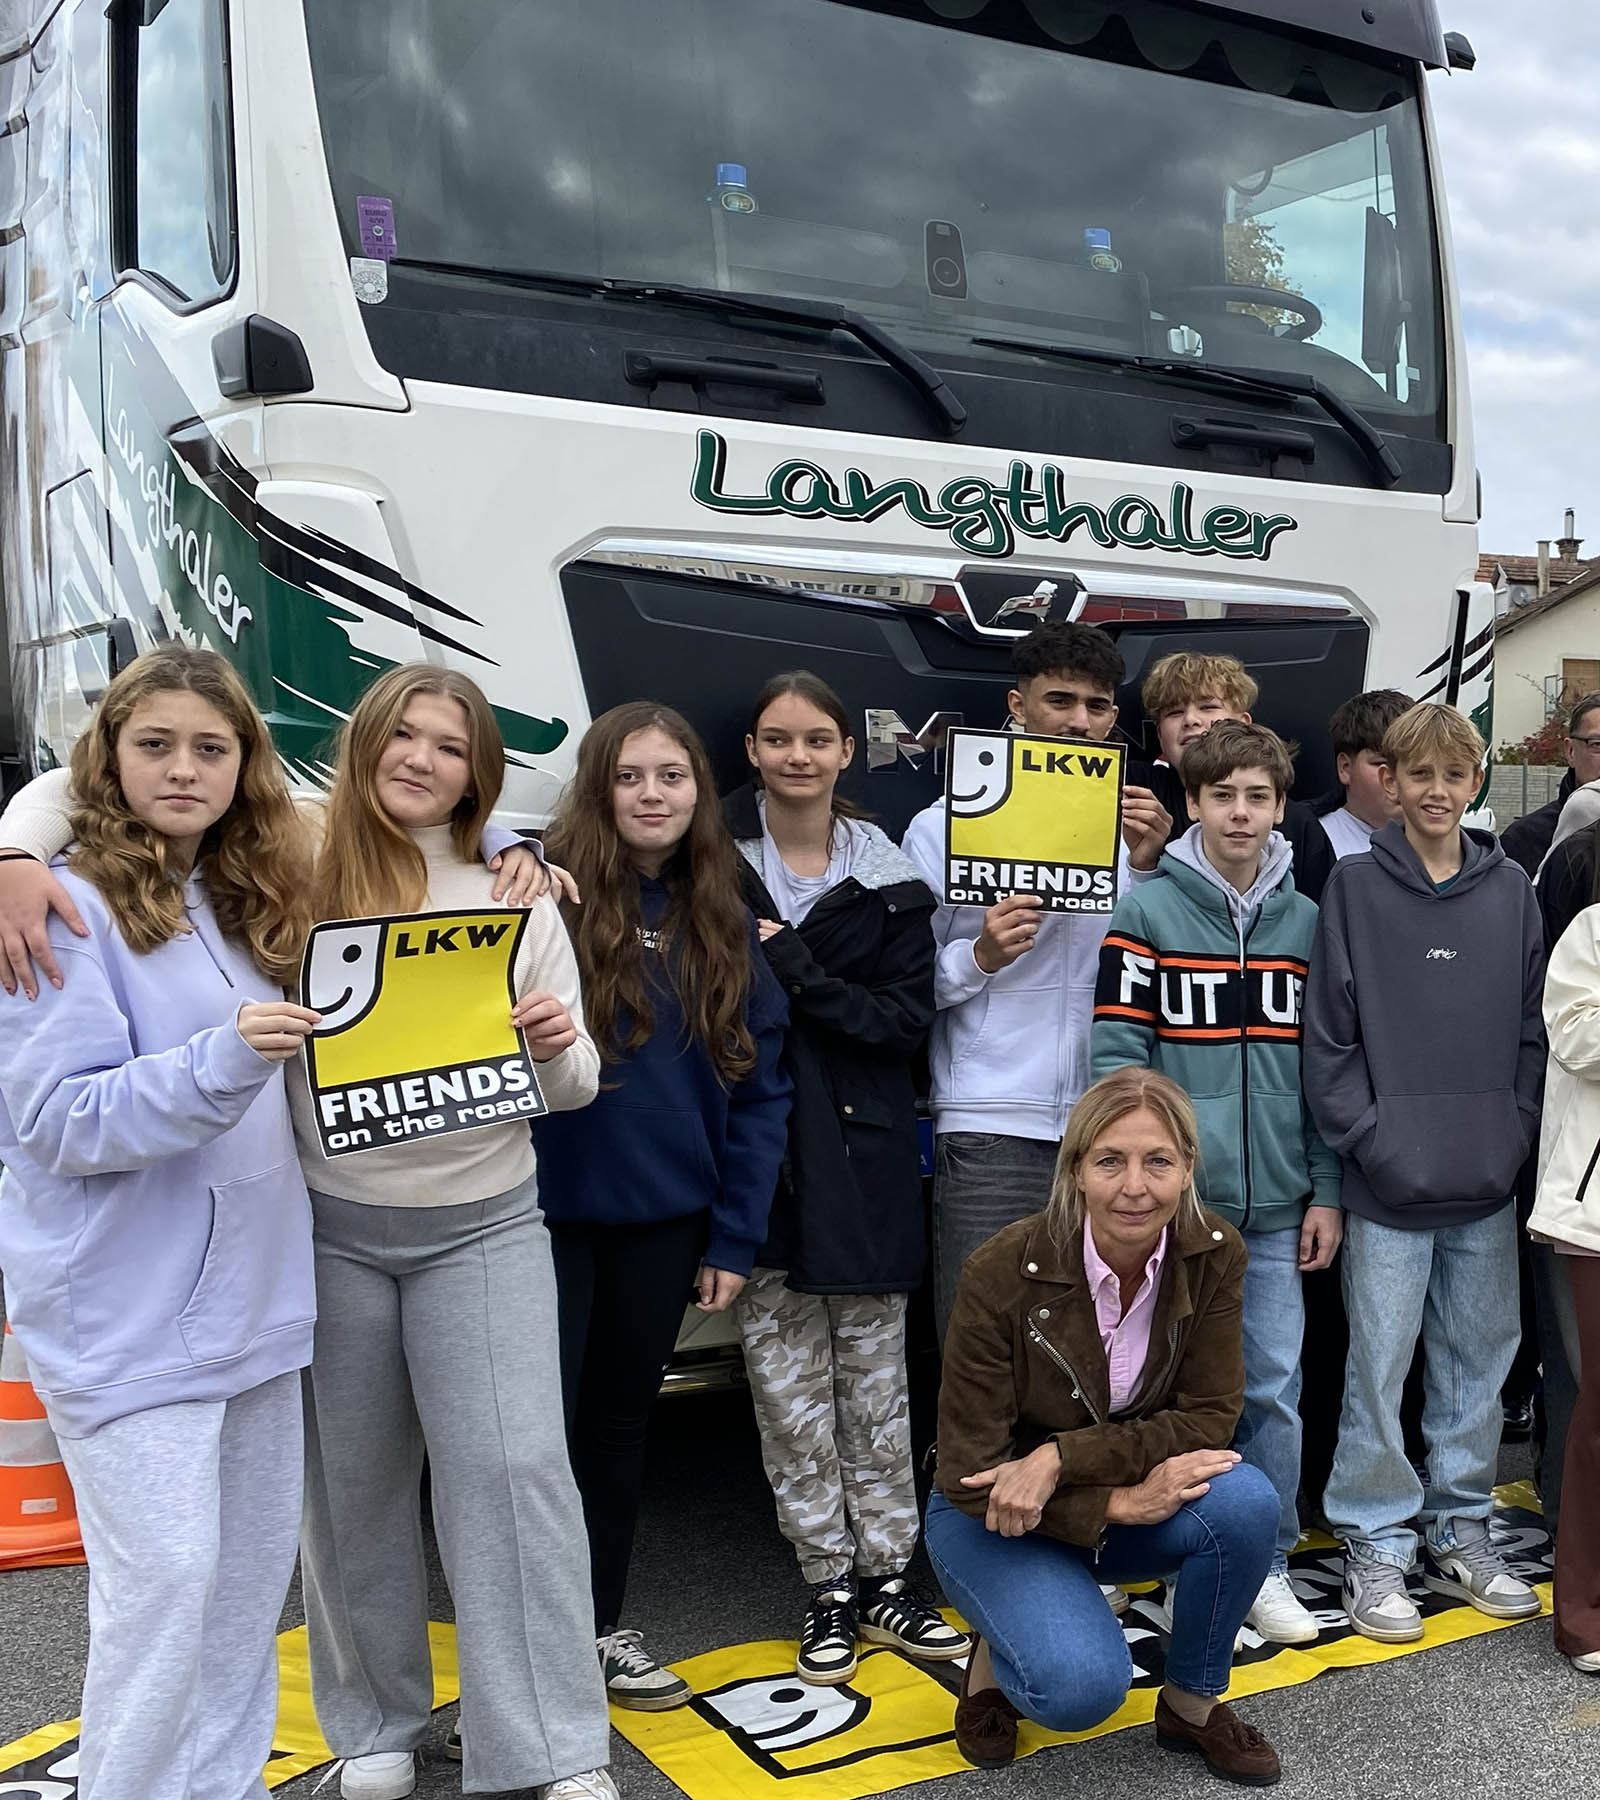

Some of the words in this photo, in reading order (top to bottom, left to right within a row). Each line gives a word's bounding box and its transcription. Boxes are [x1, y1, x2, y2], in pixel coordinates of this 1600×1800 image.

[107, 360, 253, 644] Langthaler
[690, 428, 1299, 562] Langthaler
[1021, 749, 1113, 778] LKW
[949, 889, 984, 902] on
[1051, 896, 1113, 911] road
[950, 859, 1114, 895] FRIENDS
[394, 923, 511, 958] LKW
[318, 1059, 531, 1128] FRIENDS
[327, 1127, 373, 1149] on
[384, 1115, 446, 1138] the
[457, 1091, 539, 1124] road
